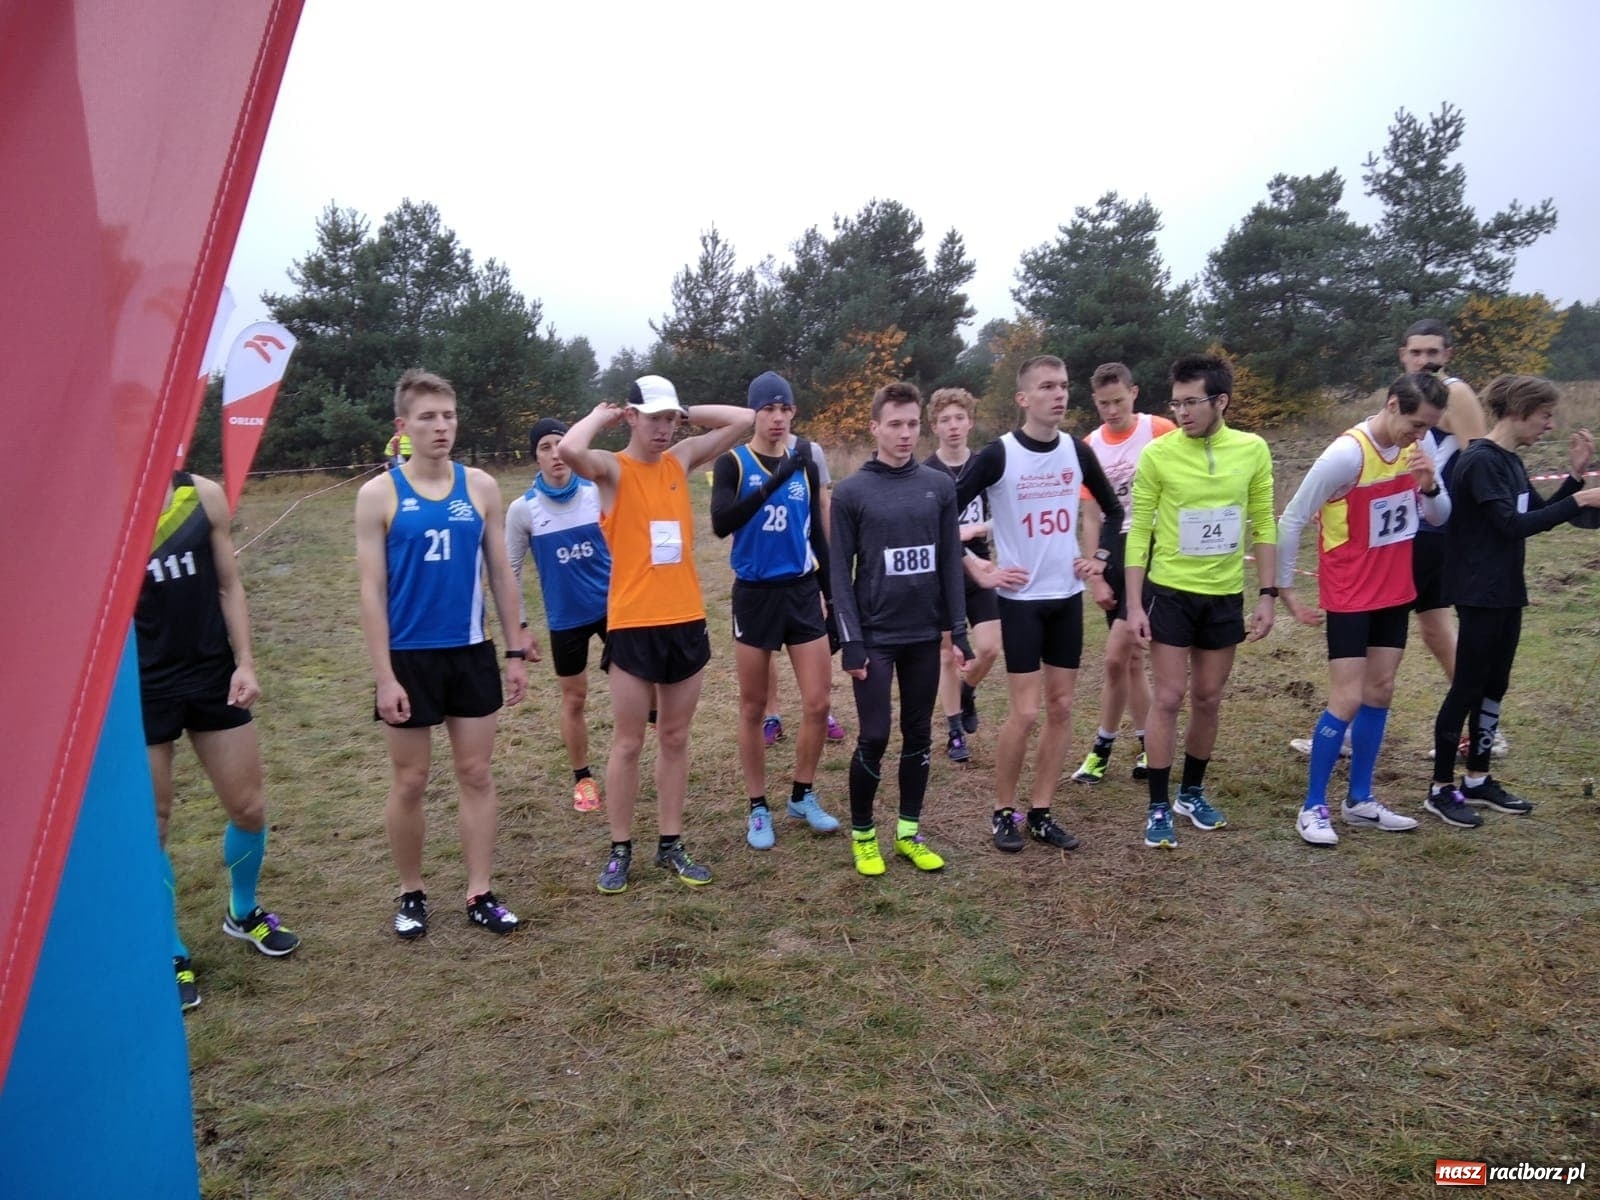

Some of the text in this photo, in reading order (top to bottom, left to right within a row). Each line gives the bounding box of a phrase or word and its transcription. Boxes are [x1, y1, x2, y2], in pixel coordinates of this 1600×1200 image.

[229, 416, 264, 426] ORLEN
[762, 504, 788, 532] 28
[1021, 508, 1071, 538] 150
[1202, 523, 1223, 539] 24
[1378, 504, 1408, 537] 13
[423, 528, 452, 562] 21
[556, 541, 594, 564] 946
[893, 547, 931, 573] 888
